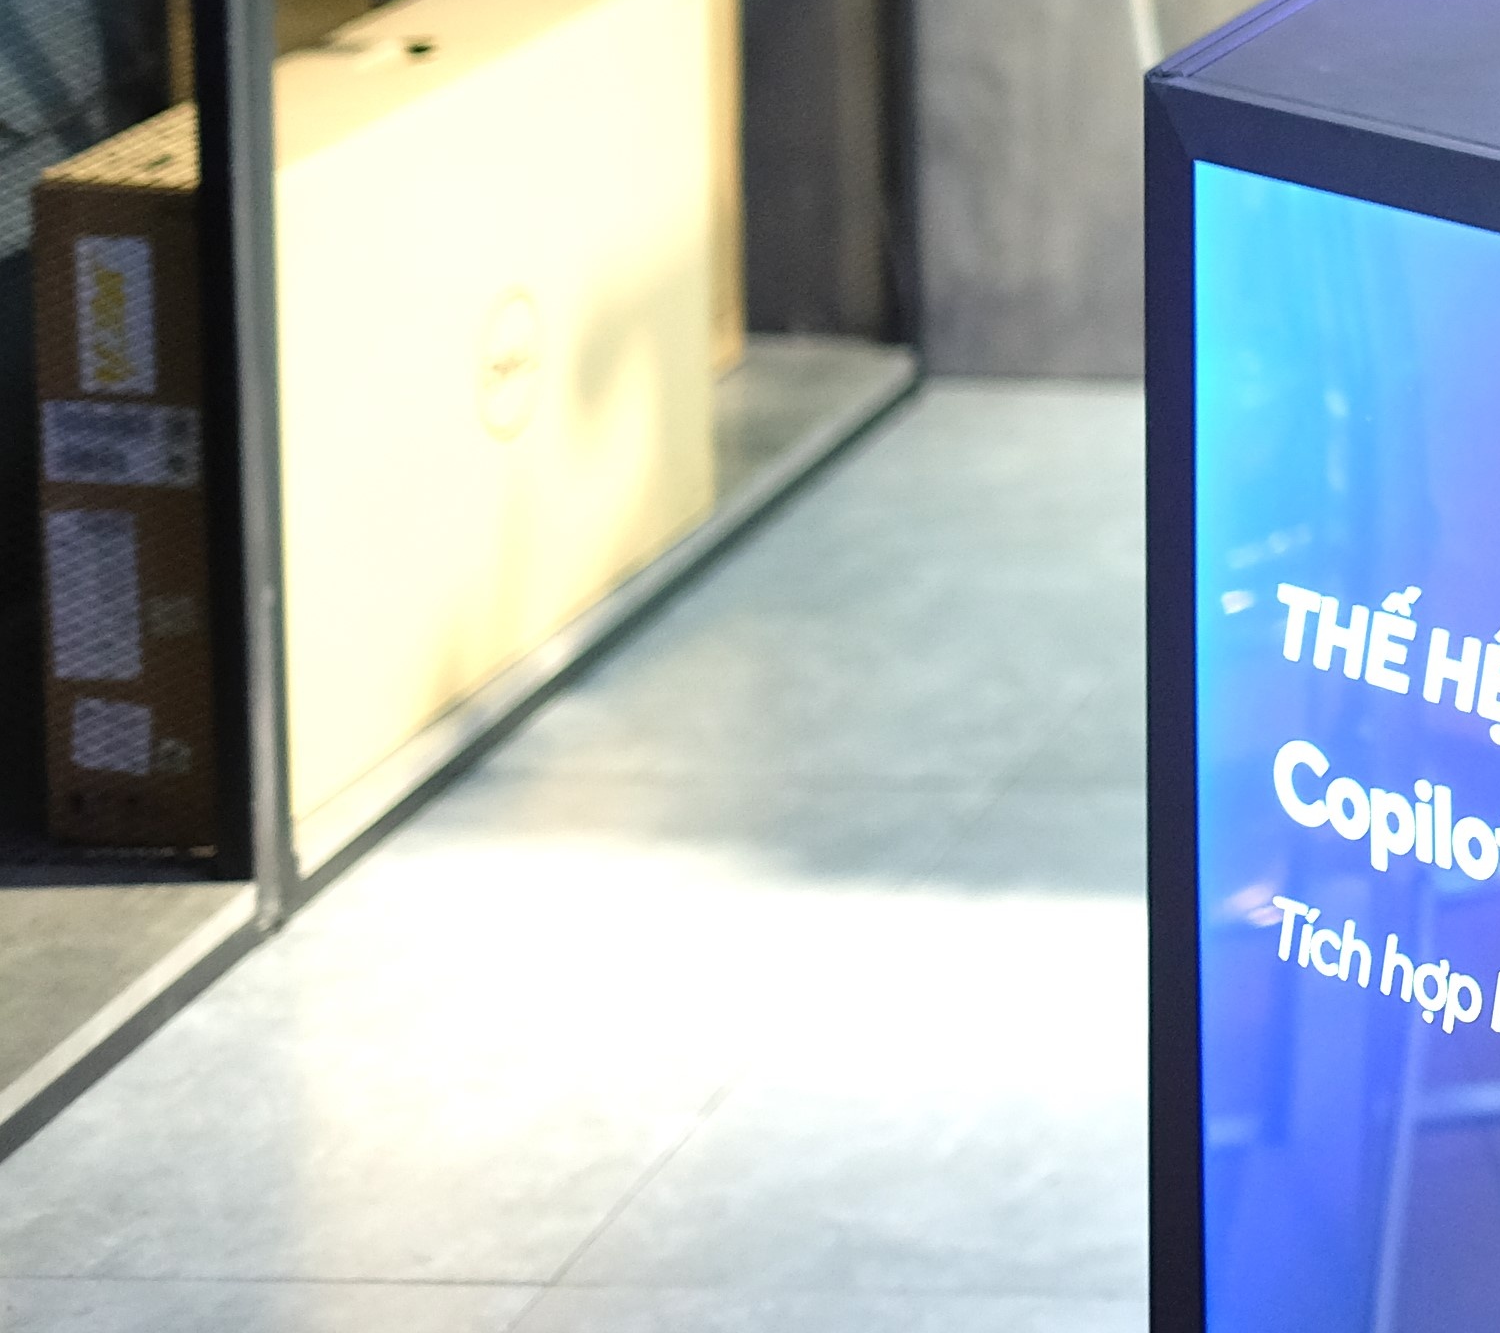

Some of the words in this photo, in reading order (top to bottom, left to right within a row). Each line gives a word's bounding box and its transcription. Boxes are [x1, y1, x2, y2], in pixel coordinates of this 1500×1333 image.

[1277, 583, 1422, 695] THẾ
[1271, 895, 1373, 988] Tích
[1379, 933, 1483, 1035] hợp
